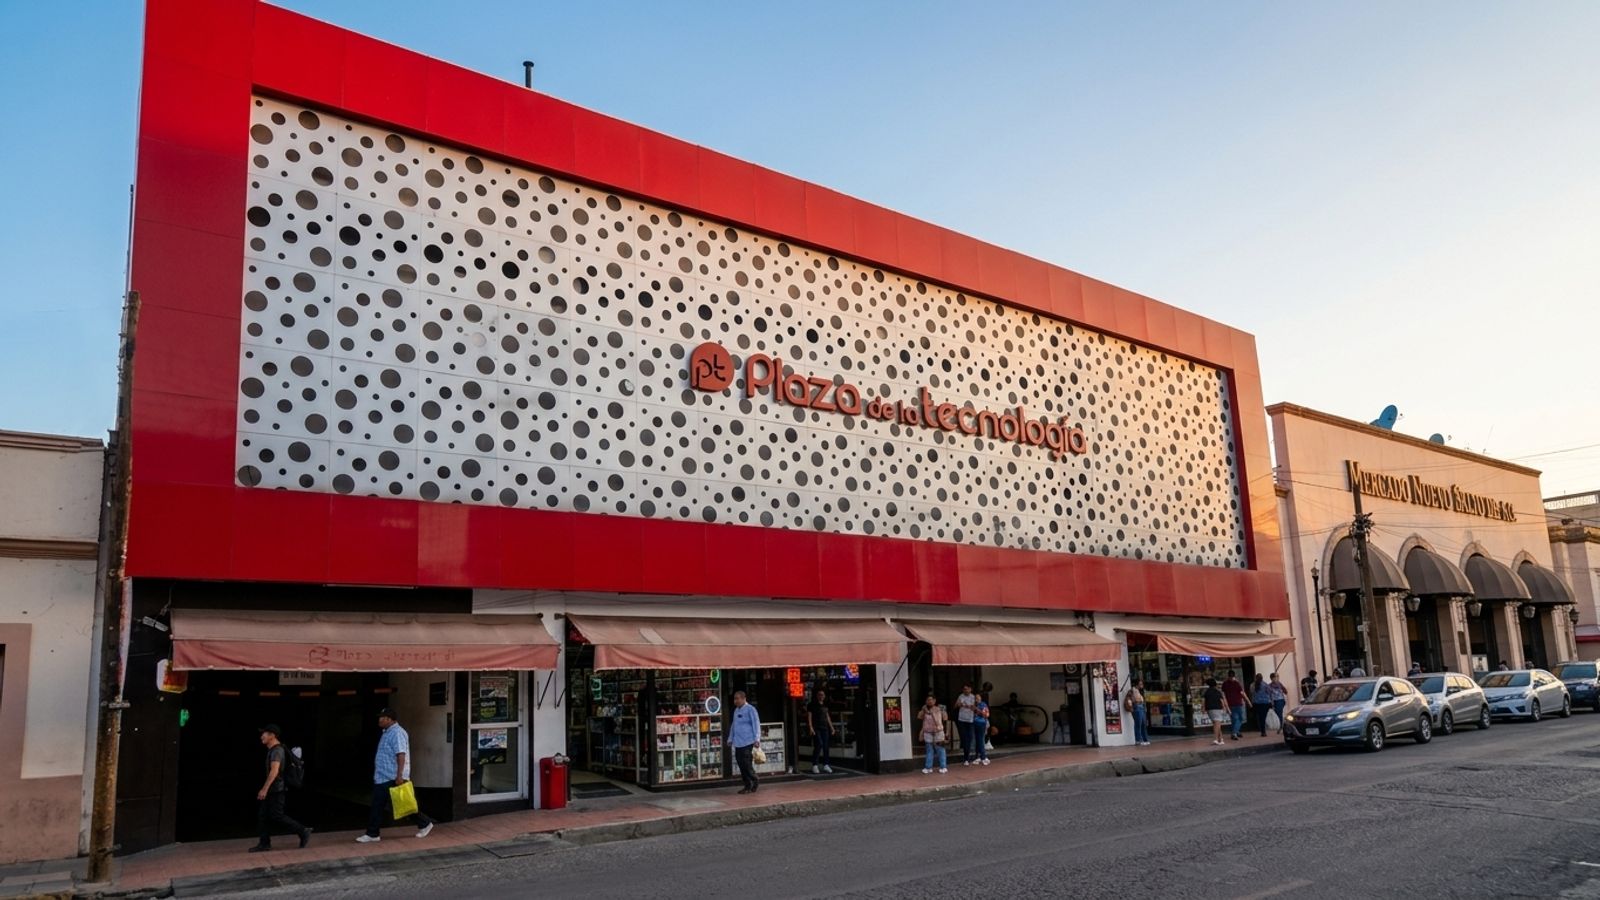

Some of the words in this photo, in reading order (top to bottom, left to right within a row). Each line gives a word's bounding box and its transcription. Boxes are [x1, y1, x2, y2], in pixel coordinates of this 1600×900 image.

[745, 353, 862, 416] Plaza
[866, 395, 896, 421] de
[896, 399, 920, 426] la
[919, 386, 1087, 462] tecnología
